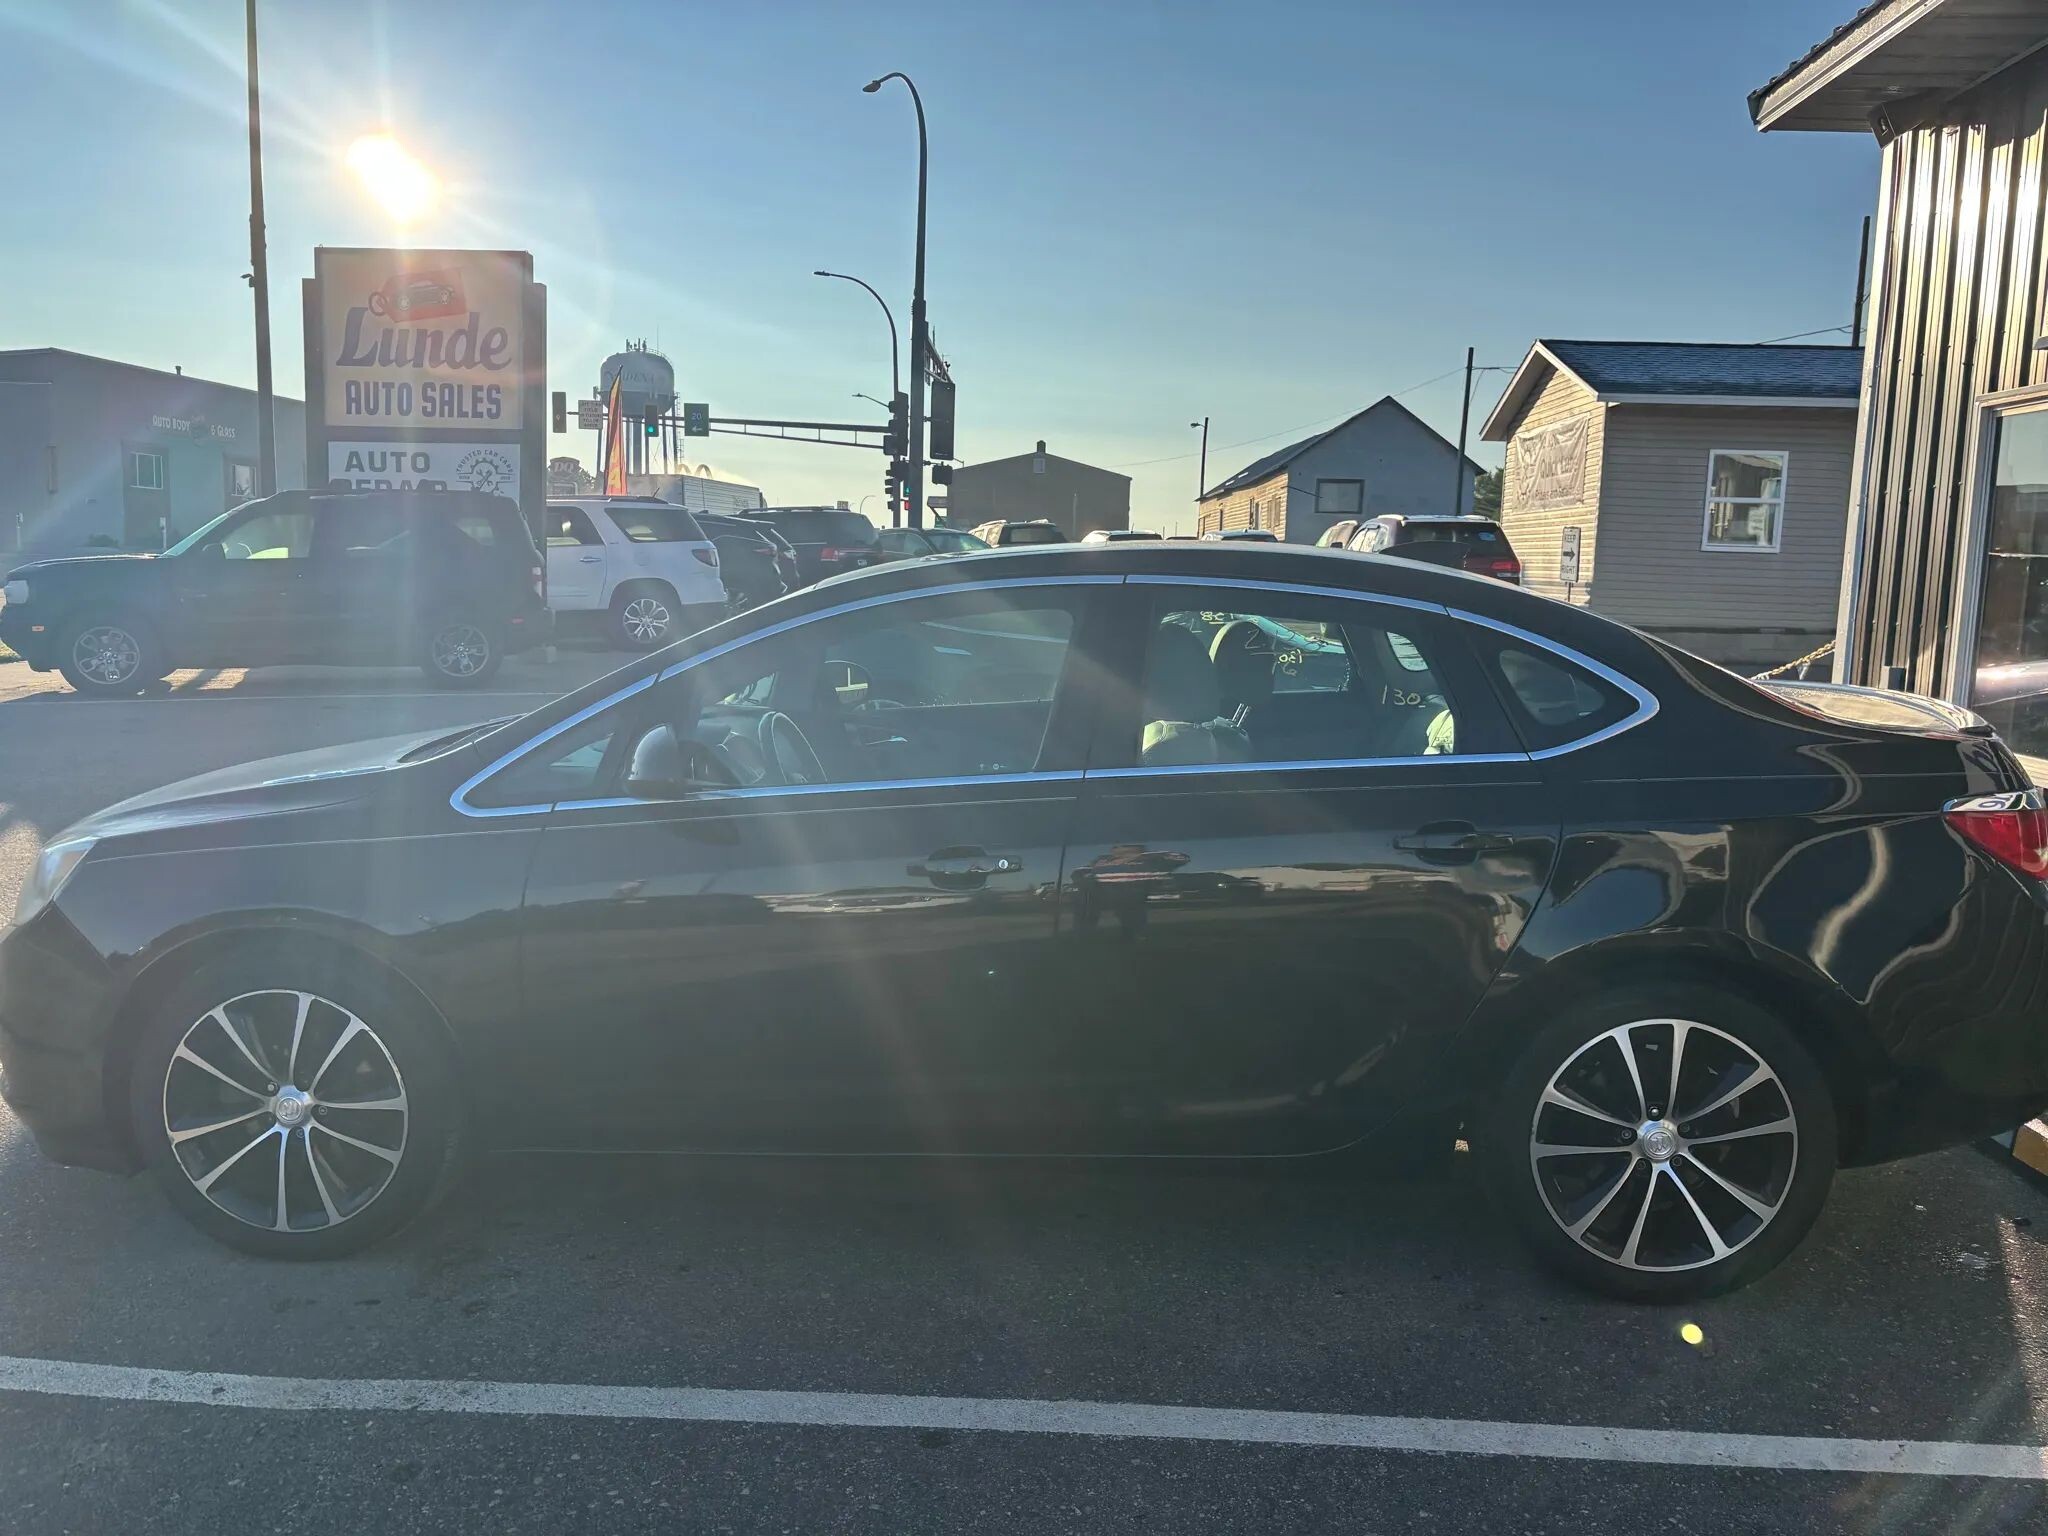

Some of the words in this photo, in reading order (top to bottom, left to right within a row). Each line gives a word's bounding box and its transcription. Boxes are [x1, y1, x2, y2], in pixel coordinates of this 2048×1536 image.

[336, 307, 512, 371] Lunde
[345, 380, 413, 416] AUTO
[421, 382, 502, 419] SALES
[344, 451, 431, 474] AUTO
[554, 462, 574, 473] DQ
